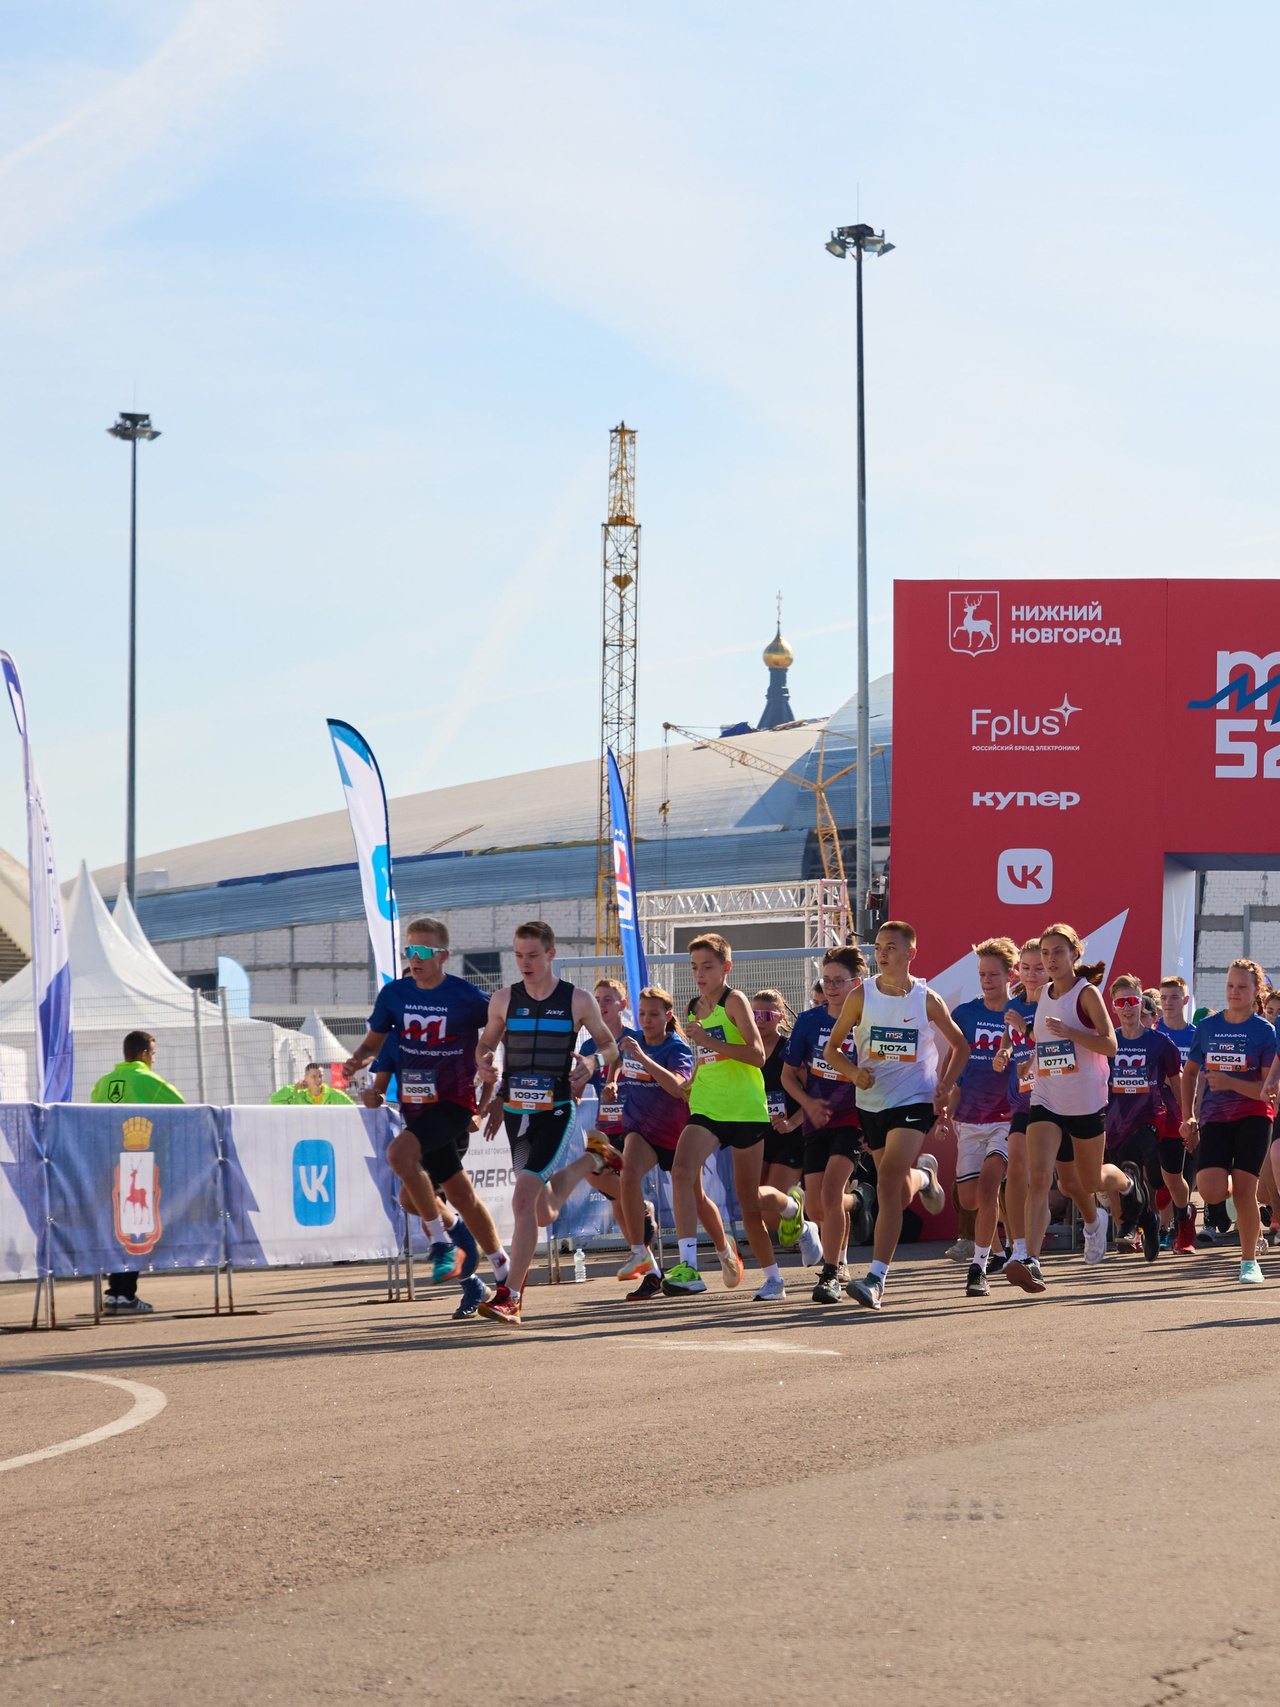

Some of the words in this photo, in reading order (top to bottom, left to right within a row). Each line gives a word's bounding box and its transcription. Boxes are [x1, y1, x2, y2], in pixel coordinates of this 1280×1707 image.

[1011, 601, 1102, 622] НИЖНИЙ
[1011, 628, 1122, 646] НОВГОРОД
[971, 708, 1061, 742] Fplus
[1007, 865, 1043, 890] VK
[405, 1004, 448, 1013] МАРАФОН
[879, 1044, 908, 1052] 11074
[1043, 1057, 1068, 1066] 10771
[514, 1091, 546, 1100] 10937
[299, 1165, 329, 1202] VK
[466, 1168, 516, 1189] ORERO
